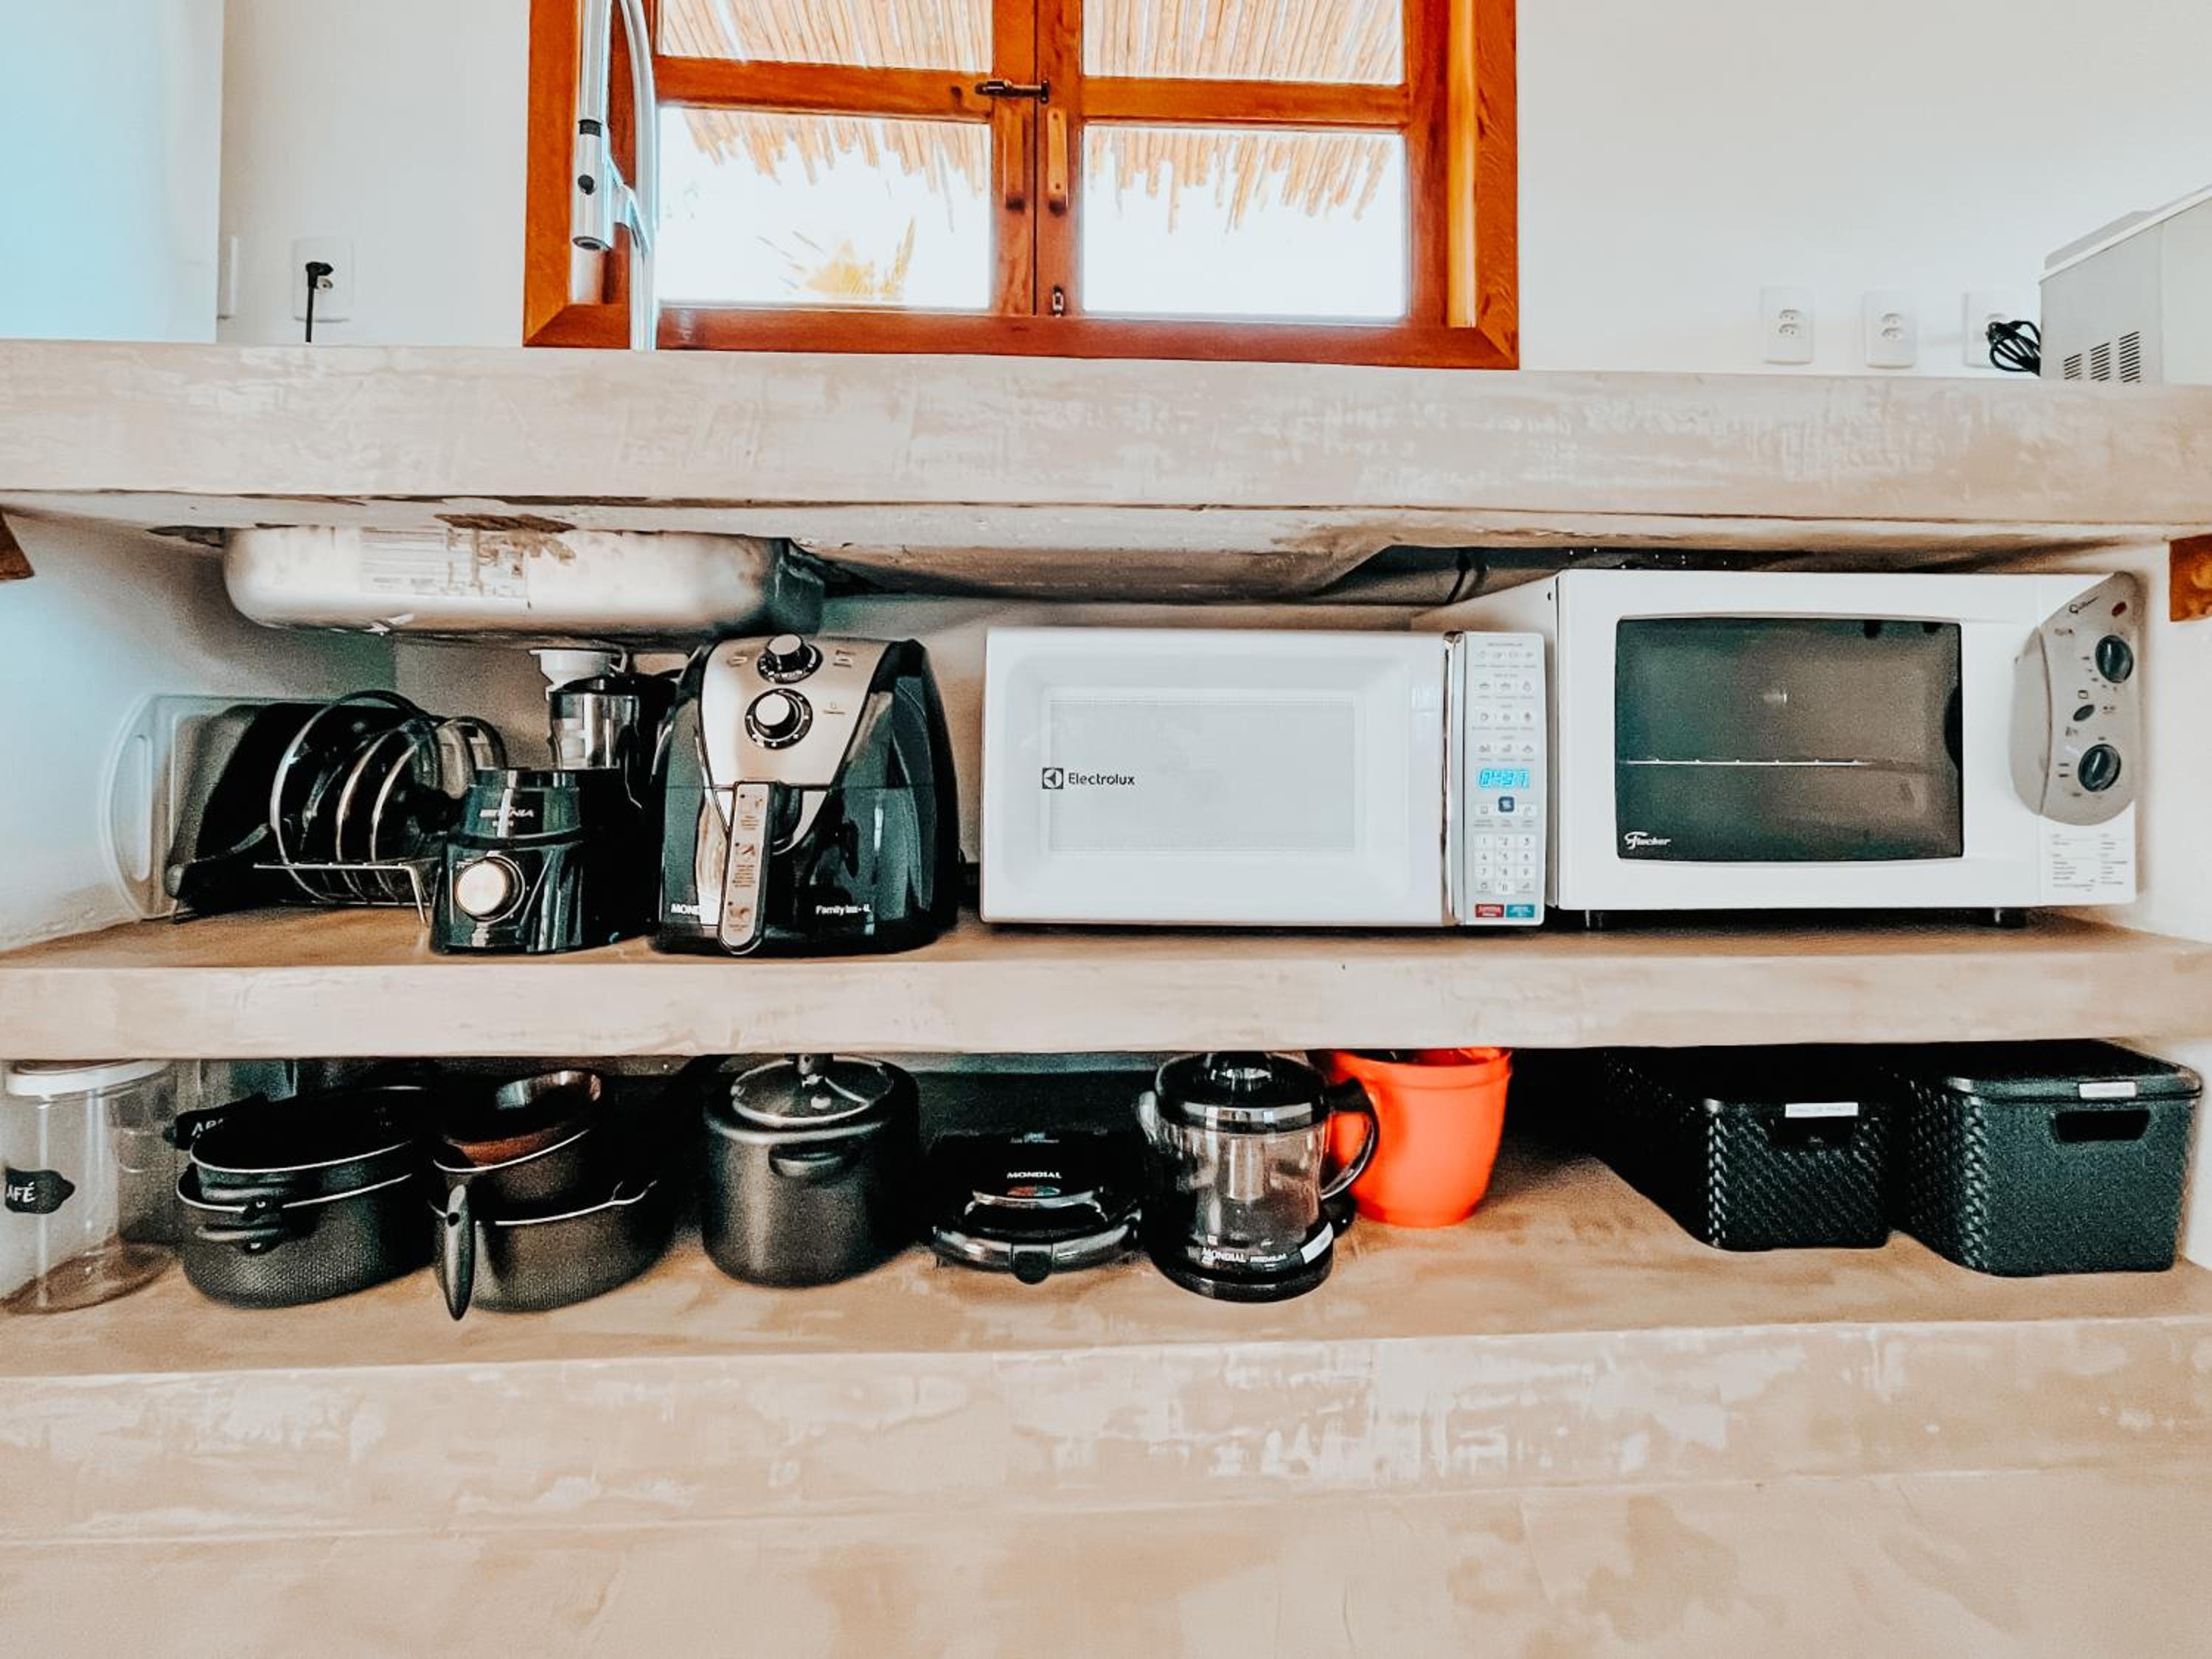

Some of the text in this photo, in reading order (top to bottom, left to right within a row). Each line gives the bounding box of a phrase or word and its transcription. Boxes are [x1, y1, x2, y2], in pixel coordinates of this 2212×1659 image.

[1068, 771, 1135, 785] Electrolux
[1006, 1171, 1062, 1179] MONDIAL
[5, 1180, 36, 1203] AFÉ
